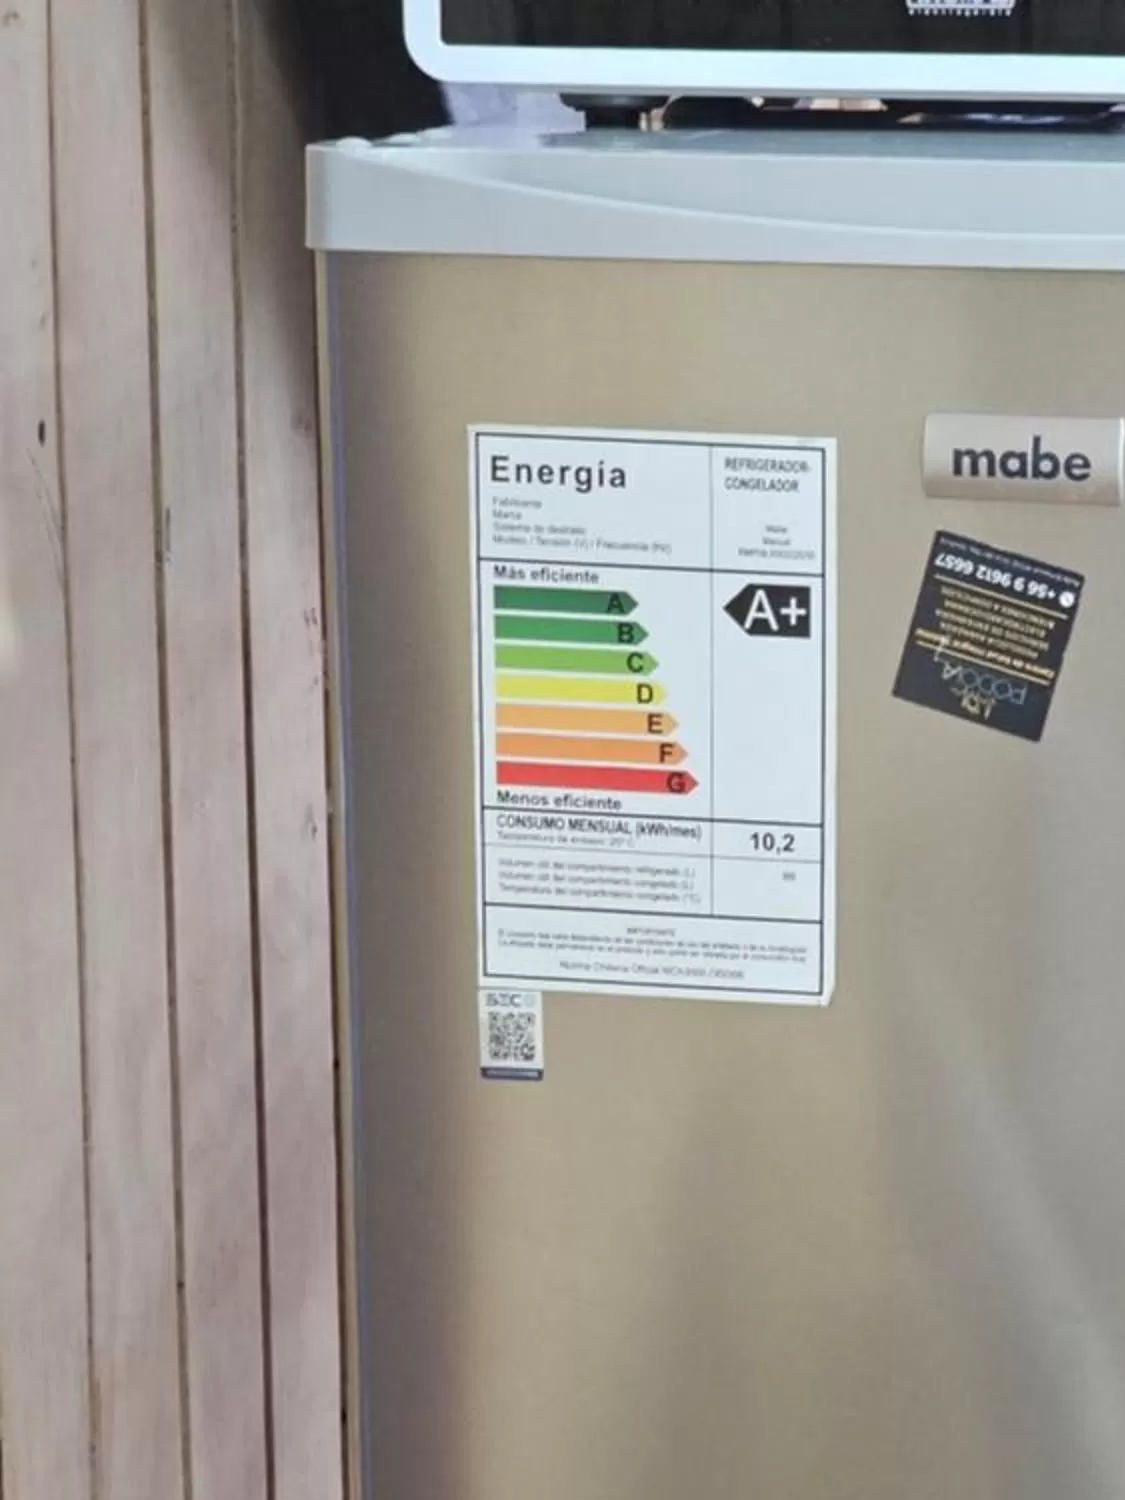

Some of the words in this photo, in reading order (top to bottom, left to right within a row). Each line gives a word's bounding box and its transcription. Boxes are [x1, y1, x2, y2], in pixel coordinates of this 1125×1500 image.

[953, 435, 1091, 480] mabe
[724, 477, 800, 493] CONGELADOR
[494, 565, 526, 581] Más
[530, 567, 600, 585] eficiente
[606, 594, 626, 614] A
[744, 589, 807, 631] A+
[617, 623, 635, 645] B
[626, 652, 644, 673] C
[637, 683, 654, 704] D
[647, 712, 663, 733] E
[659, 743, 674, 763] F
[666, 771, 686, 793] G
[497, 790, 549, 806] Menos
[554, 794, 621, 811] eficiente
[496, 814, 565, 830] CONSUMO
[568, 818, 632, 834] MENSUAL
[636, 822, 702, 842] (kWh/mes)
[750, 832, 796, 853] 10,2
